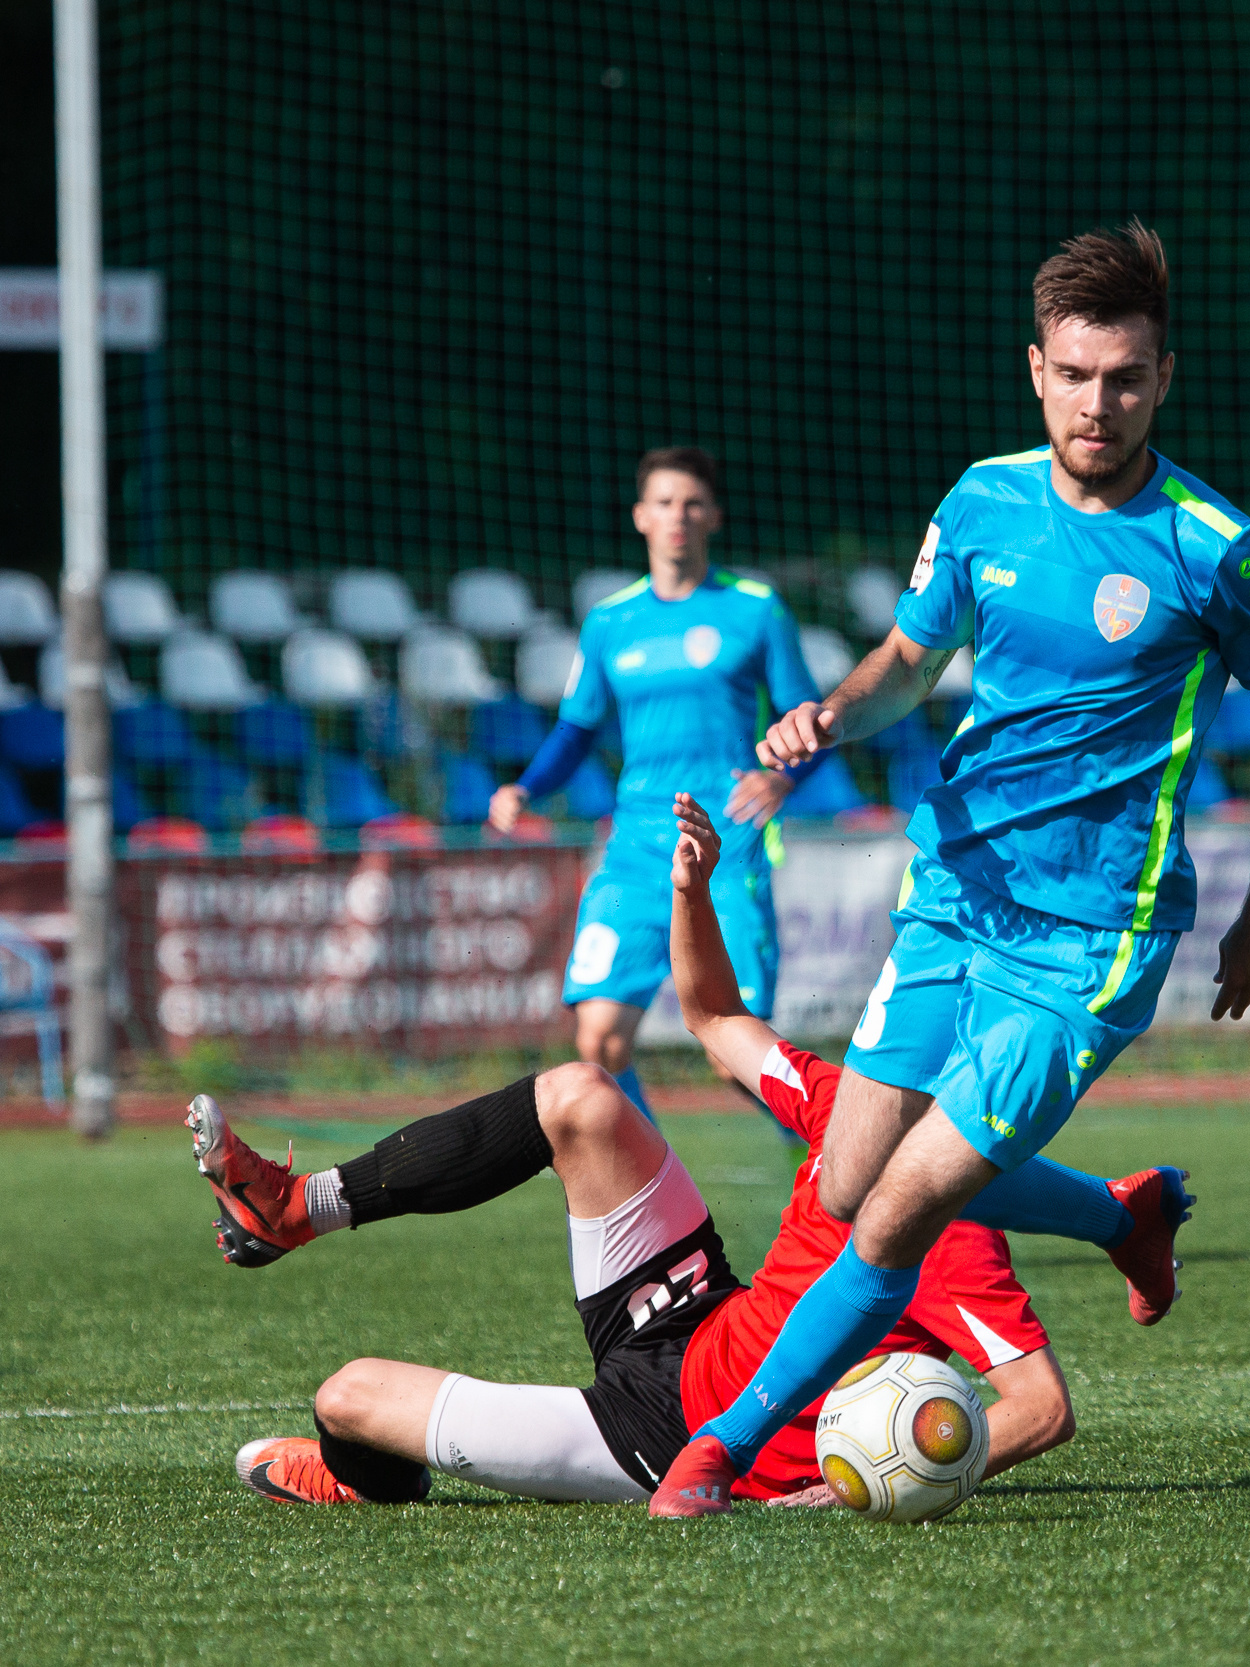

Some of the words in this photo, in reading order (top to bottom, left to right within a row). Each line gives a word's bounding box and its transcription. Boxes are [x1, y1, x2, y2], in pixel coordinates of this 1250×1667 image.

[981, 566, 1017, 588] JAKO
[570, 922, 620, 985] 9
[981, 1111, 1016, 1138] JAKO
[753, 1383, 795, 1416] JAKO
[817, 1413, 842, 1431] JAKO
[449, 1441, 461, 1473] adida
